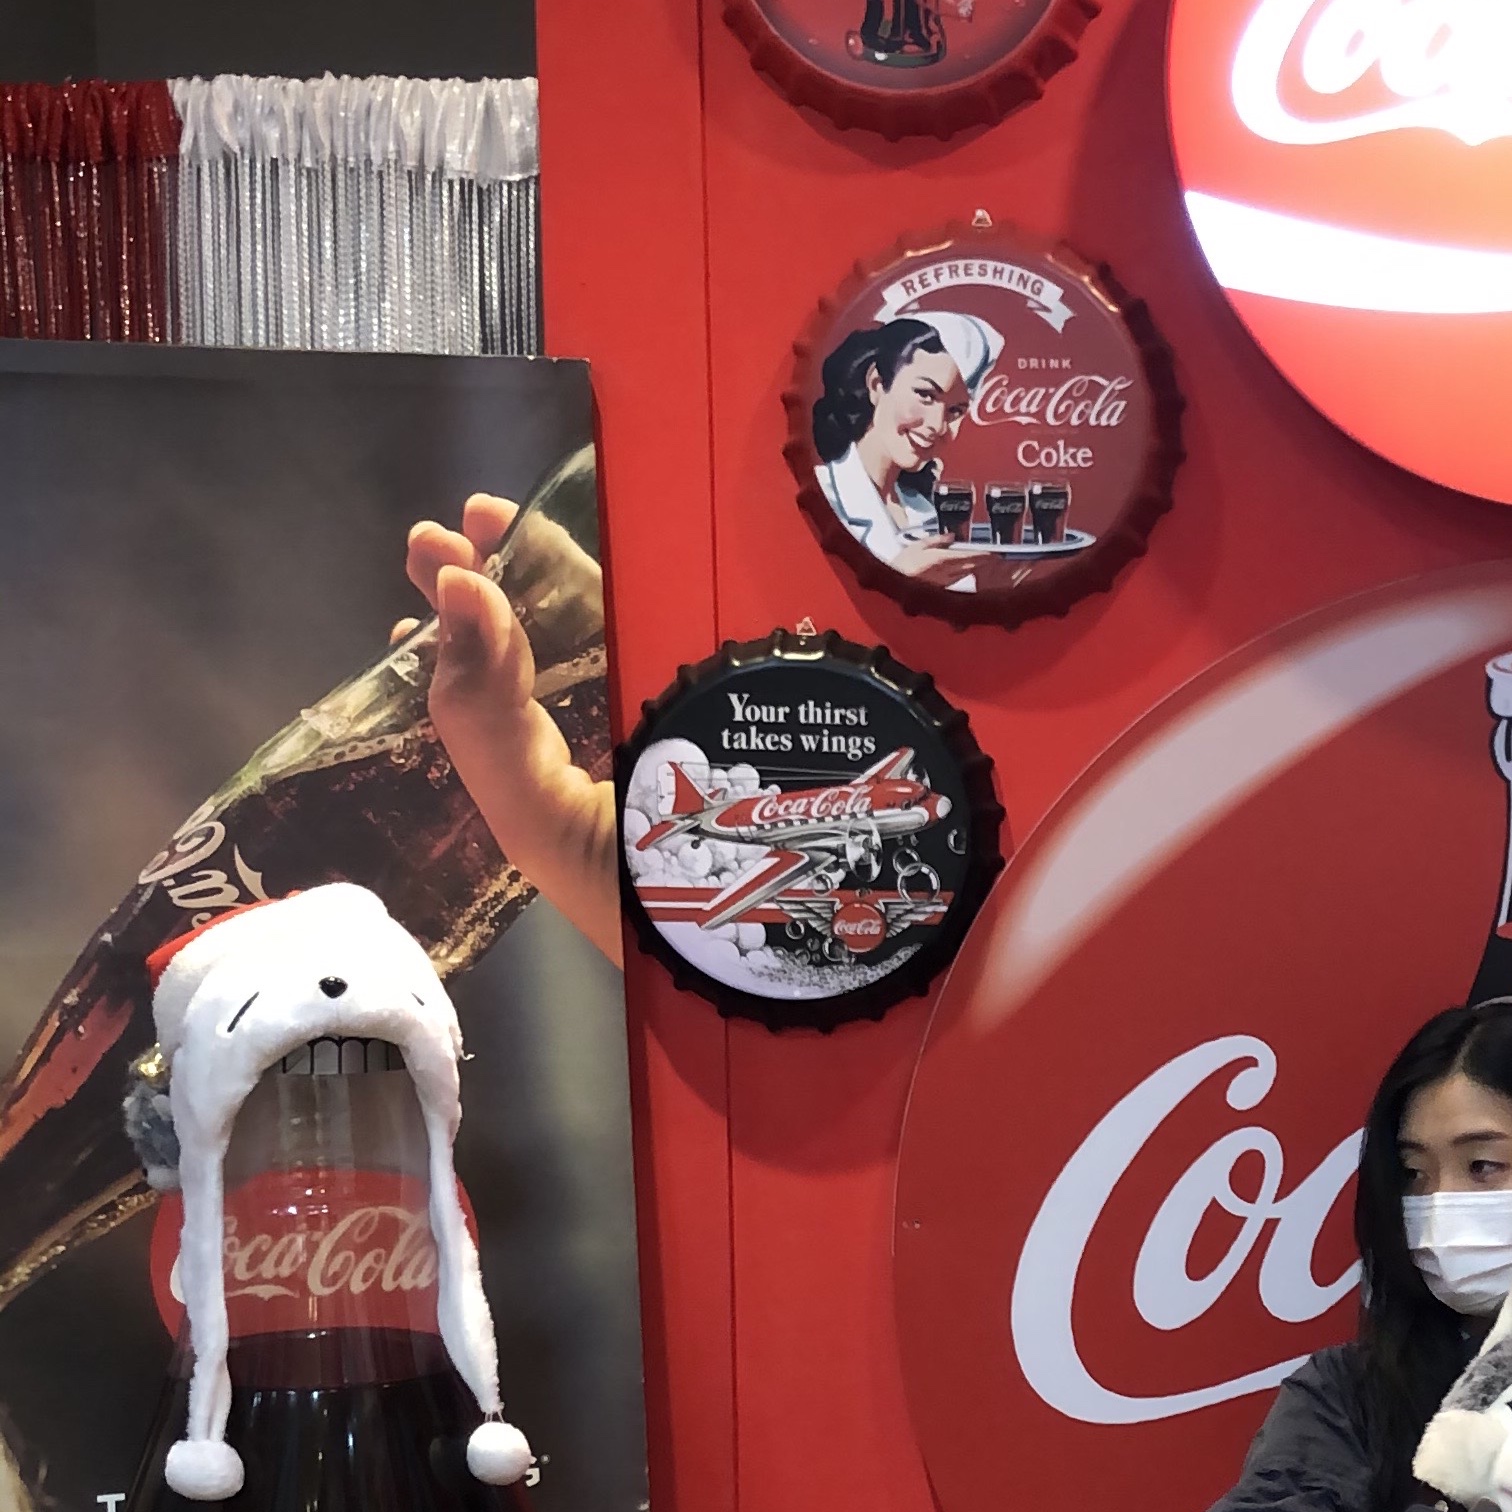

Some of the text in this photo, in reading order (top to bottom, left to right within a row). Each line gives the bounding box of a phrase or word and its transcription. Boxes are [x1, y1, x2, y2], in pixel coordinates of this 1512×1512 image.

[900, 262, 1045, 297] REFRESHING
[1017, 357, 1072, 370] DRINK
[969, 374, 1135, 428] Coca-Cola
[1016, 439, 1094, 468] Coke
[727, 692, 868, 726] Your thirst
[720, 725, 876, 762] takes wings
[752, 784, 873, 822] Coca-Cola
[170, 1206, 440, 1304] oca-Cola
